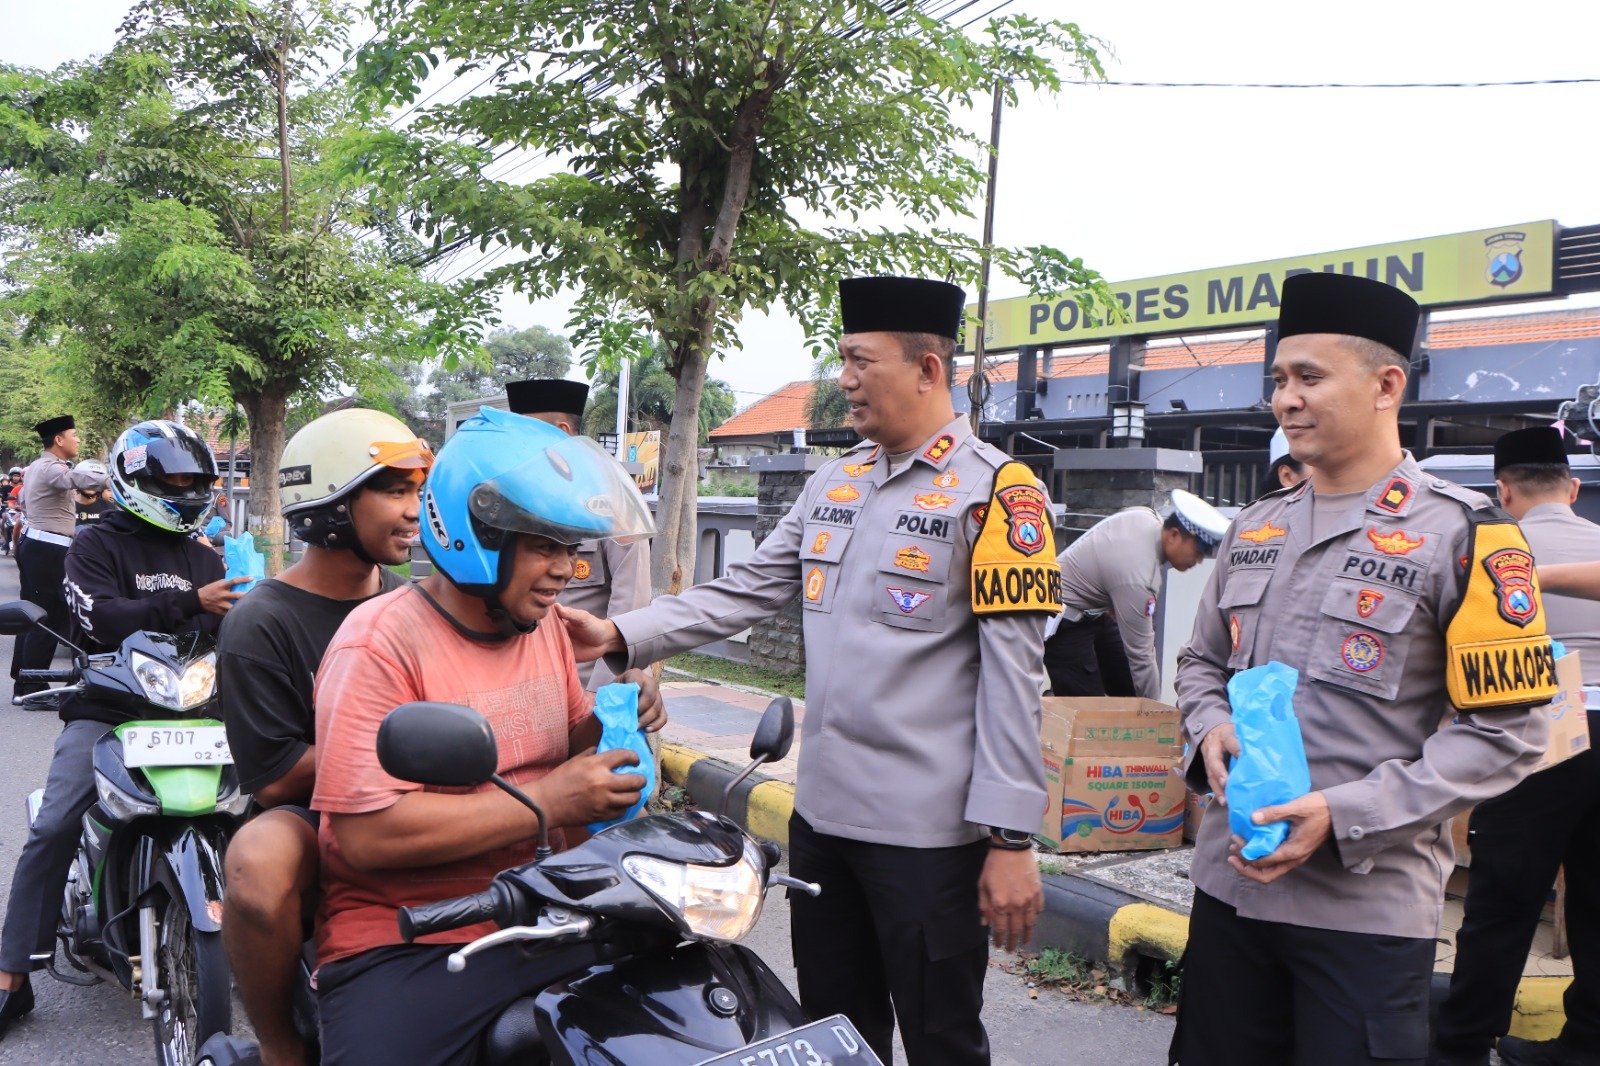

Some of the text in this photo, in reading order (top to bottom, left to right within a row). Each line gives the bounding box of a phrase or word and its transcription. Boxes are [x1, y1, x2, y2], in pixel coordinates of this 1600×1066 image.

[1029, 252, 1424, 335] POLRES MAN
[427, 493, 447, 538] INK
[896, 514, 949, 538] POLRI
[1230, 549, 1278, 566] KHADAFI
[1343, 556, 1417, 587] POLRI
[127, 731, 195, 745] P 6707
[1087, 766, 1122, 778] HIBA
[1088, 781, 1166, 791] SQUARE 1500ml
[1109, 810, 1140, 820] HIBA
[830, 1025, 859, 1056] D
